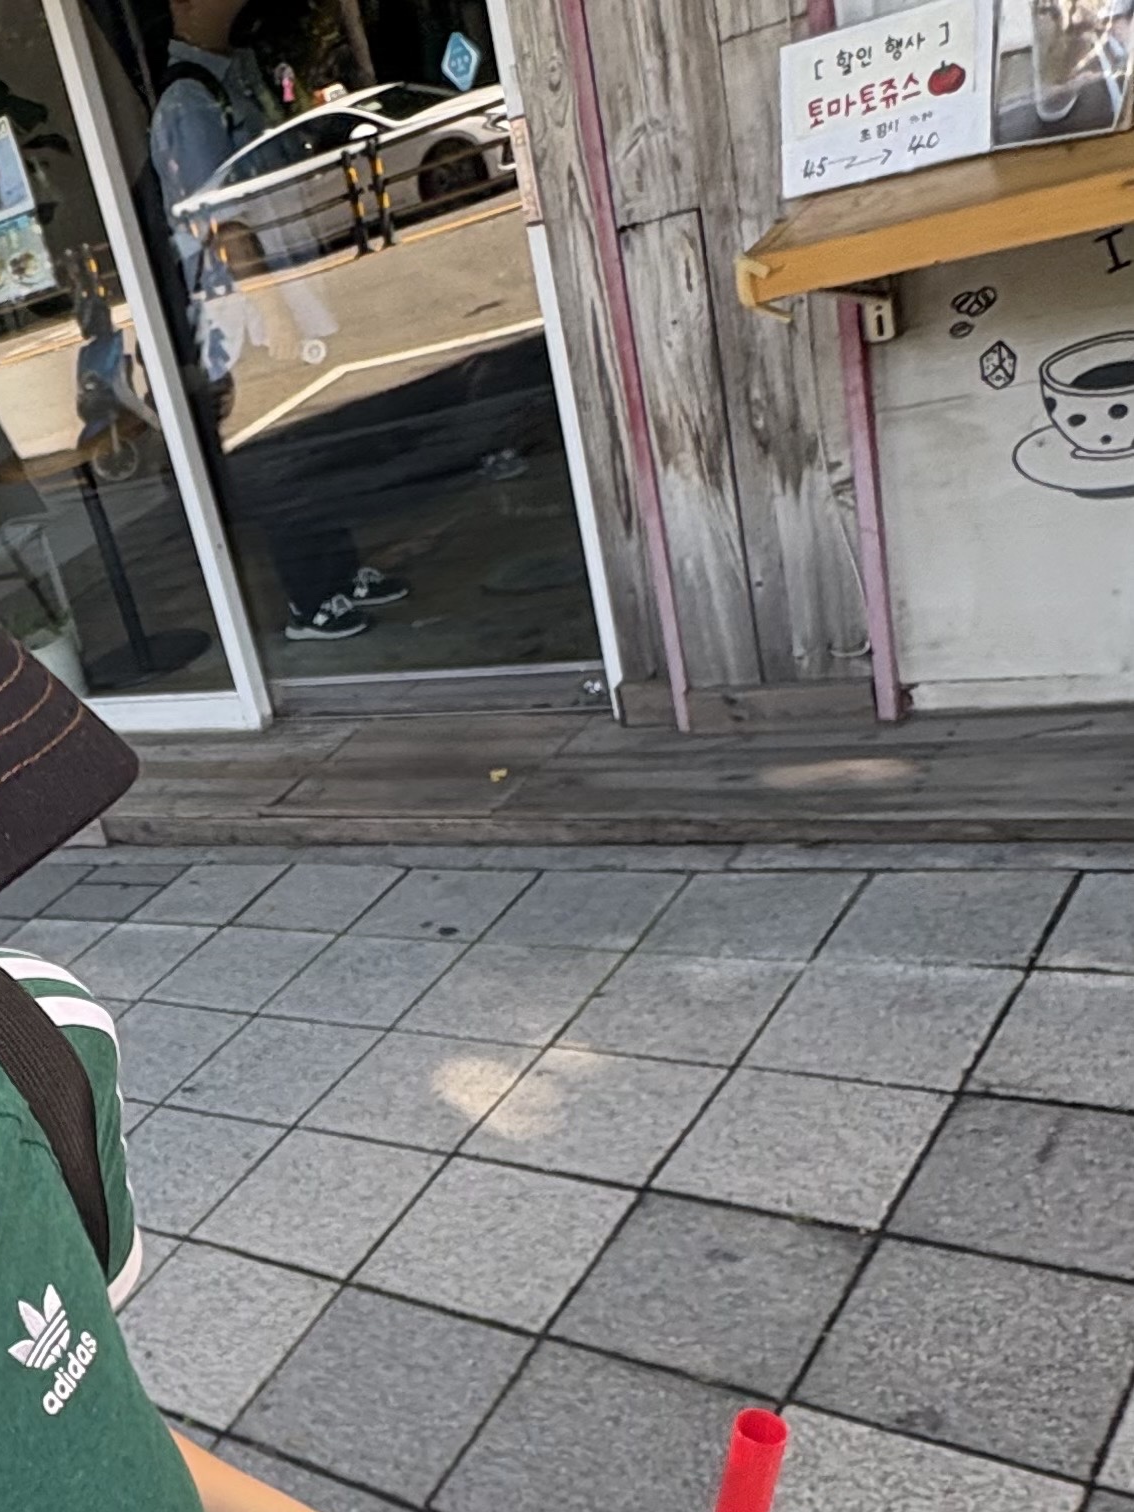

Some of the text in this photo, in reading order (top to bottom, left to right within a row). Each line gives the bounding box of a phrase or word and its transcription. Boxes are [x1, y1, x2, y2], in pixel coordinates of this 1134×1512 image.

[836, 46, 873, 76] 할인
[884, 32, 926, 61] 행사
[807, 72, 922, 129] 토마토쥬스
[42, 1331, 97, 1415] adidas
